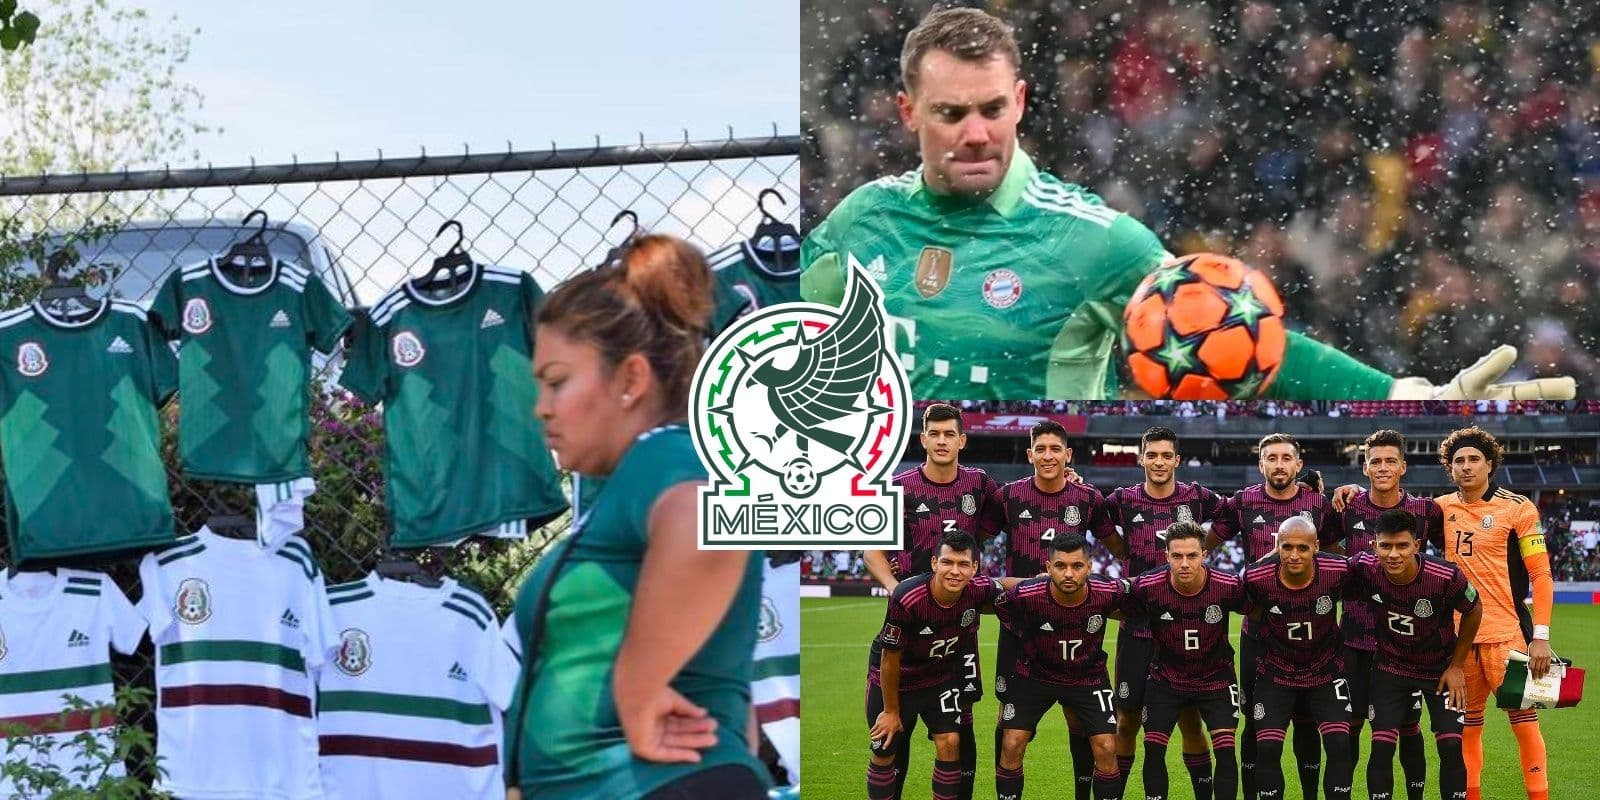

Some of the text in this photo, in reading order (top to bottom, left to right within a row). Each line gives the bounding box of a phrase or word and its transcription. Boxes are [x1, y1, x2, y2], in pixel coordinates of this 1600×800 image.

[1455, 530, 1474, 556] 13
[1286, 621, 1313, 640] 21
[1387, 610, 1414, 636] 23
[929, 636, 959, 658] 22
[1058, 639, 1083, 661] 17
[1184, 629, 1200, 650] 6
[963, 653, 977, 679] 3
[1092, 689, 1114, 712] 17
